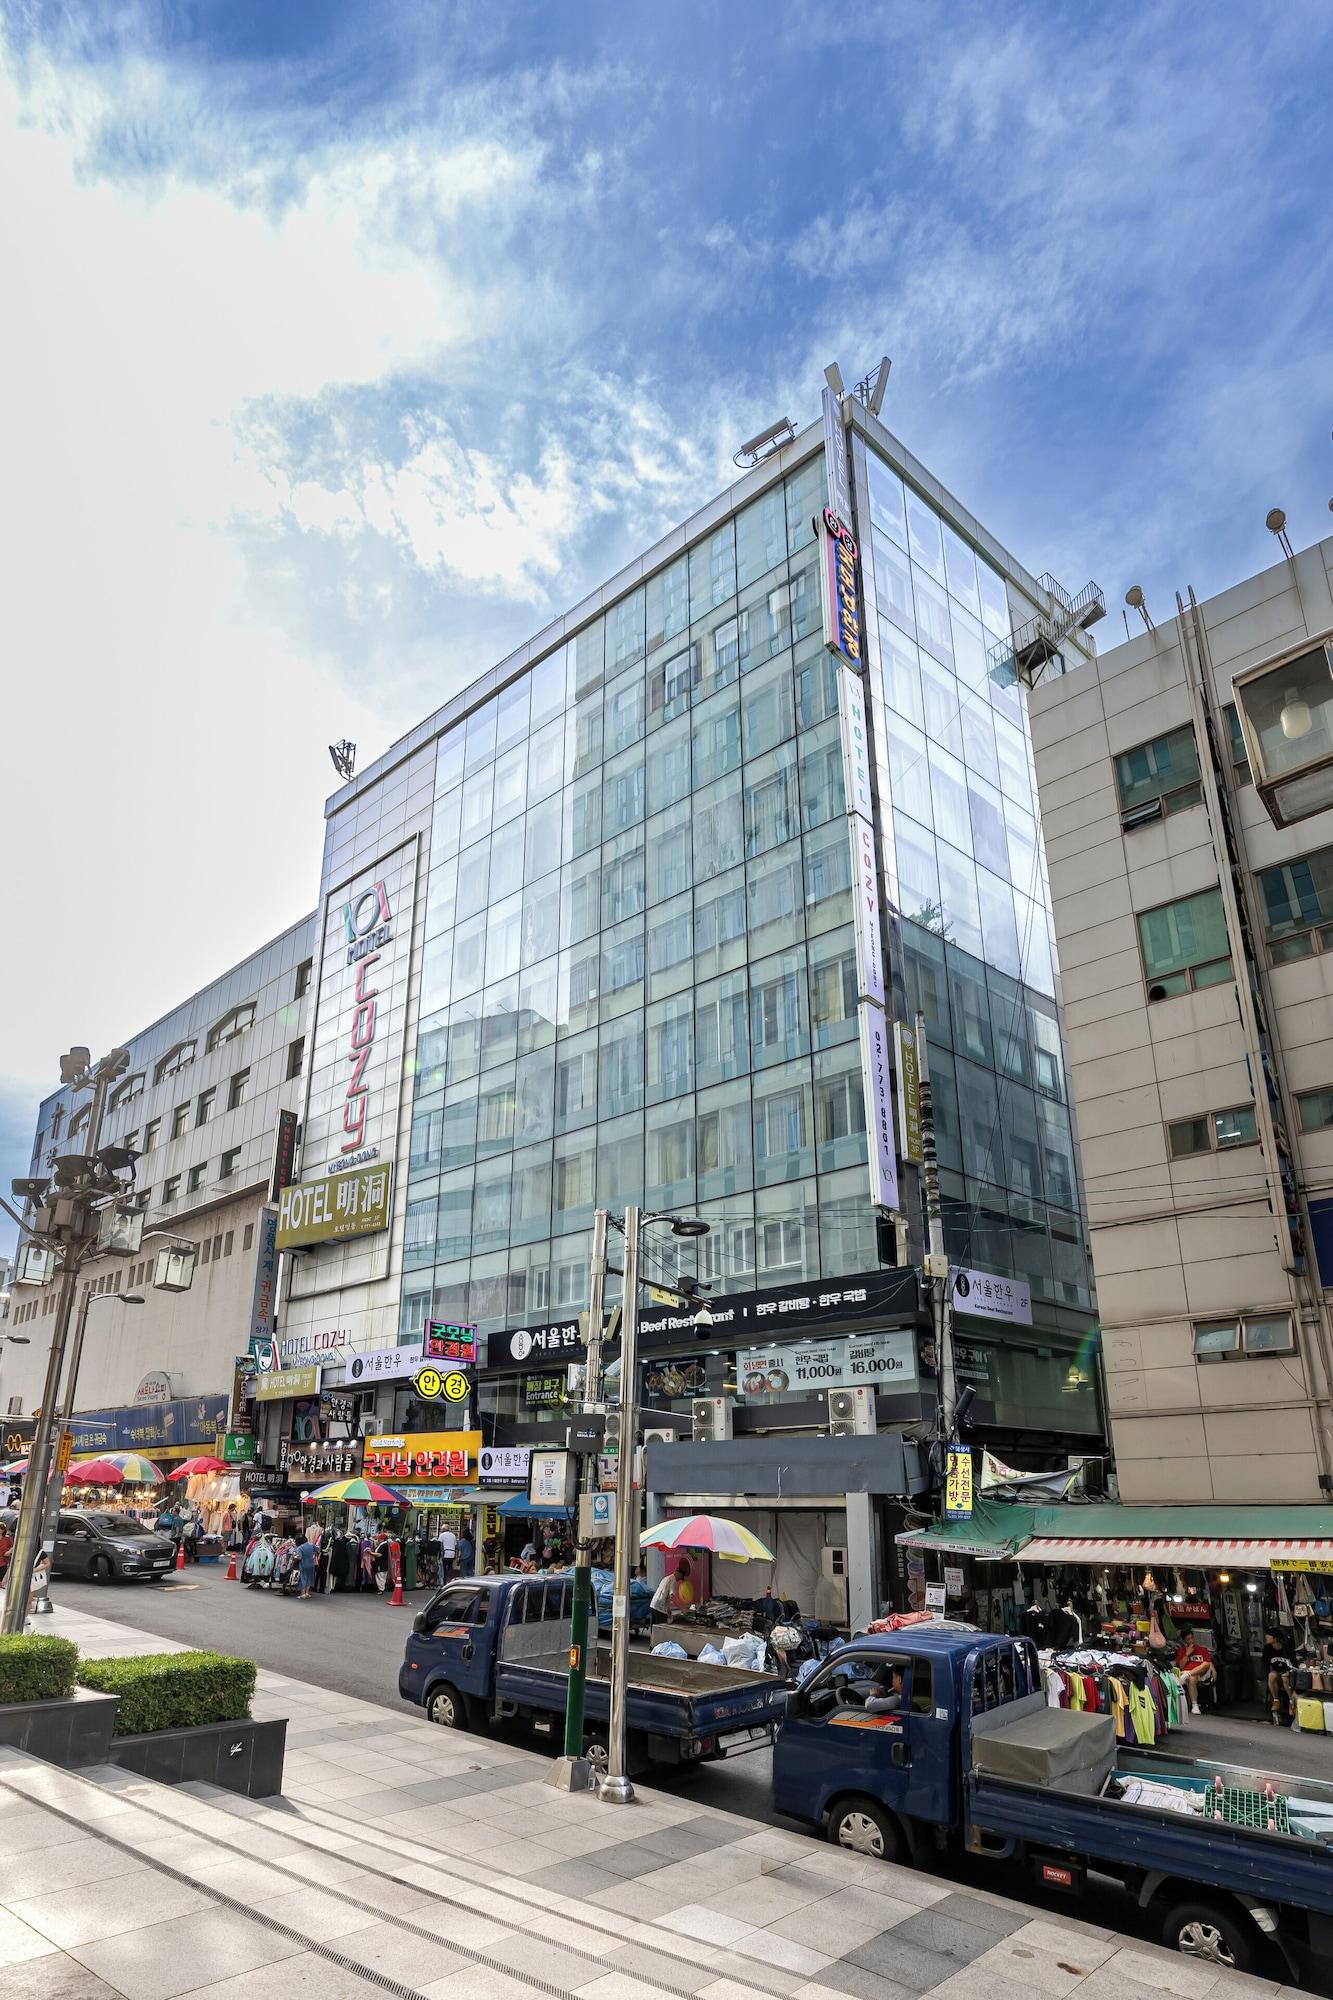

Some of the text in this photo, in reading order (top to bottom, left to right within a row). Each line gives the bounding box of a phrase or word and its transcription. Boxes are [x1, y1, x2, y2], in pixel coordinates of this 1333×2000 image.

[851, 703, 875, 913] HOTEL COZY
[341, 924, 393, 1154] HOTEL COZY
[905, 1052, 916, 1107] HOTEL
[336, 1171, 387, 1216] 明洞
[279, 1182, 333, 1231] HOTEL
[819, 1288, 868, 1307] 한우 국밥
[973, 1279, 1014, 1302] 서울한우
[756, 1297, 811, 1317] 한우 갈비탕
[431, 1322, 474, 1343] 굿모닝
[640, 1317, 669, 1334] Beef
[313, 1329, 346, 1351] COZY
[532, 1325, 581, 1350] 서울한
[429, 1338, 475, 1361] 안경원
[795, 1352, 829, 1366] 한우 국밥
[849, 1347, 875, 1359] 갈비탕
[365, 1353, 402, 1371] 서울한우
[238, 1381, 248, 1413] COFFEE
[525, 1390, 558, 1401] Entrance
[363, 1450, 469, 1477] 굿모닝 안경원
[494, 1452, 529, 1466] 서울한우
[244, 1471, 266, 1482] HOTEL
[961, 1456, 971, 1503] 수선전문
